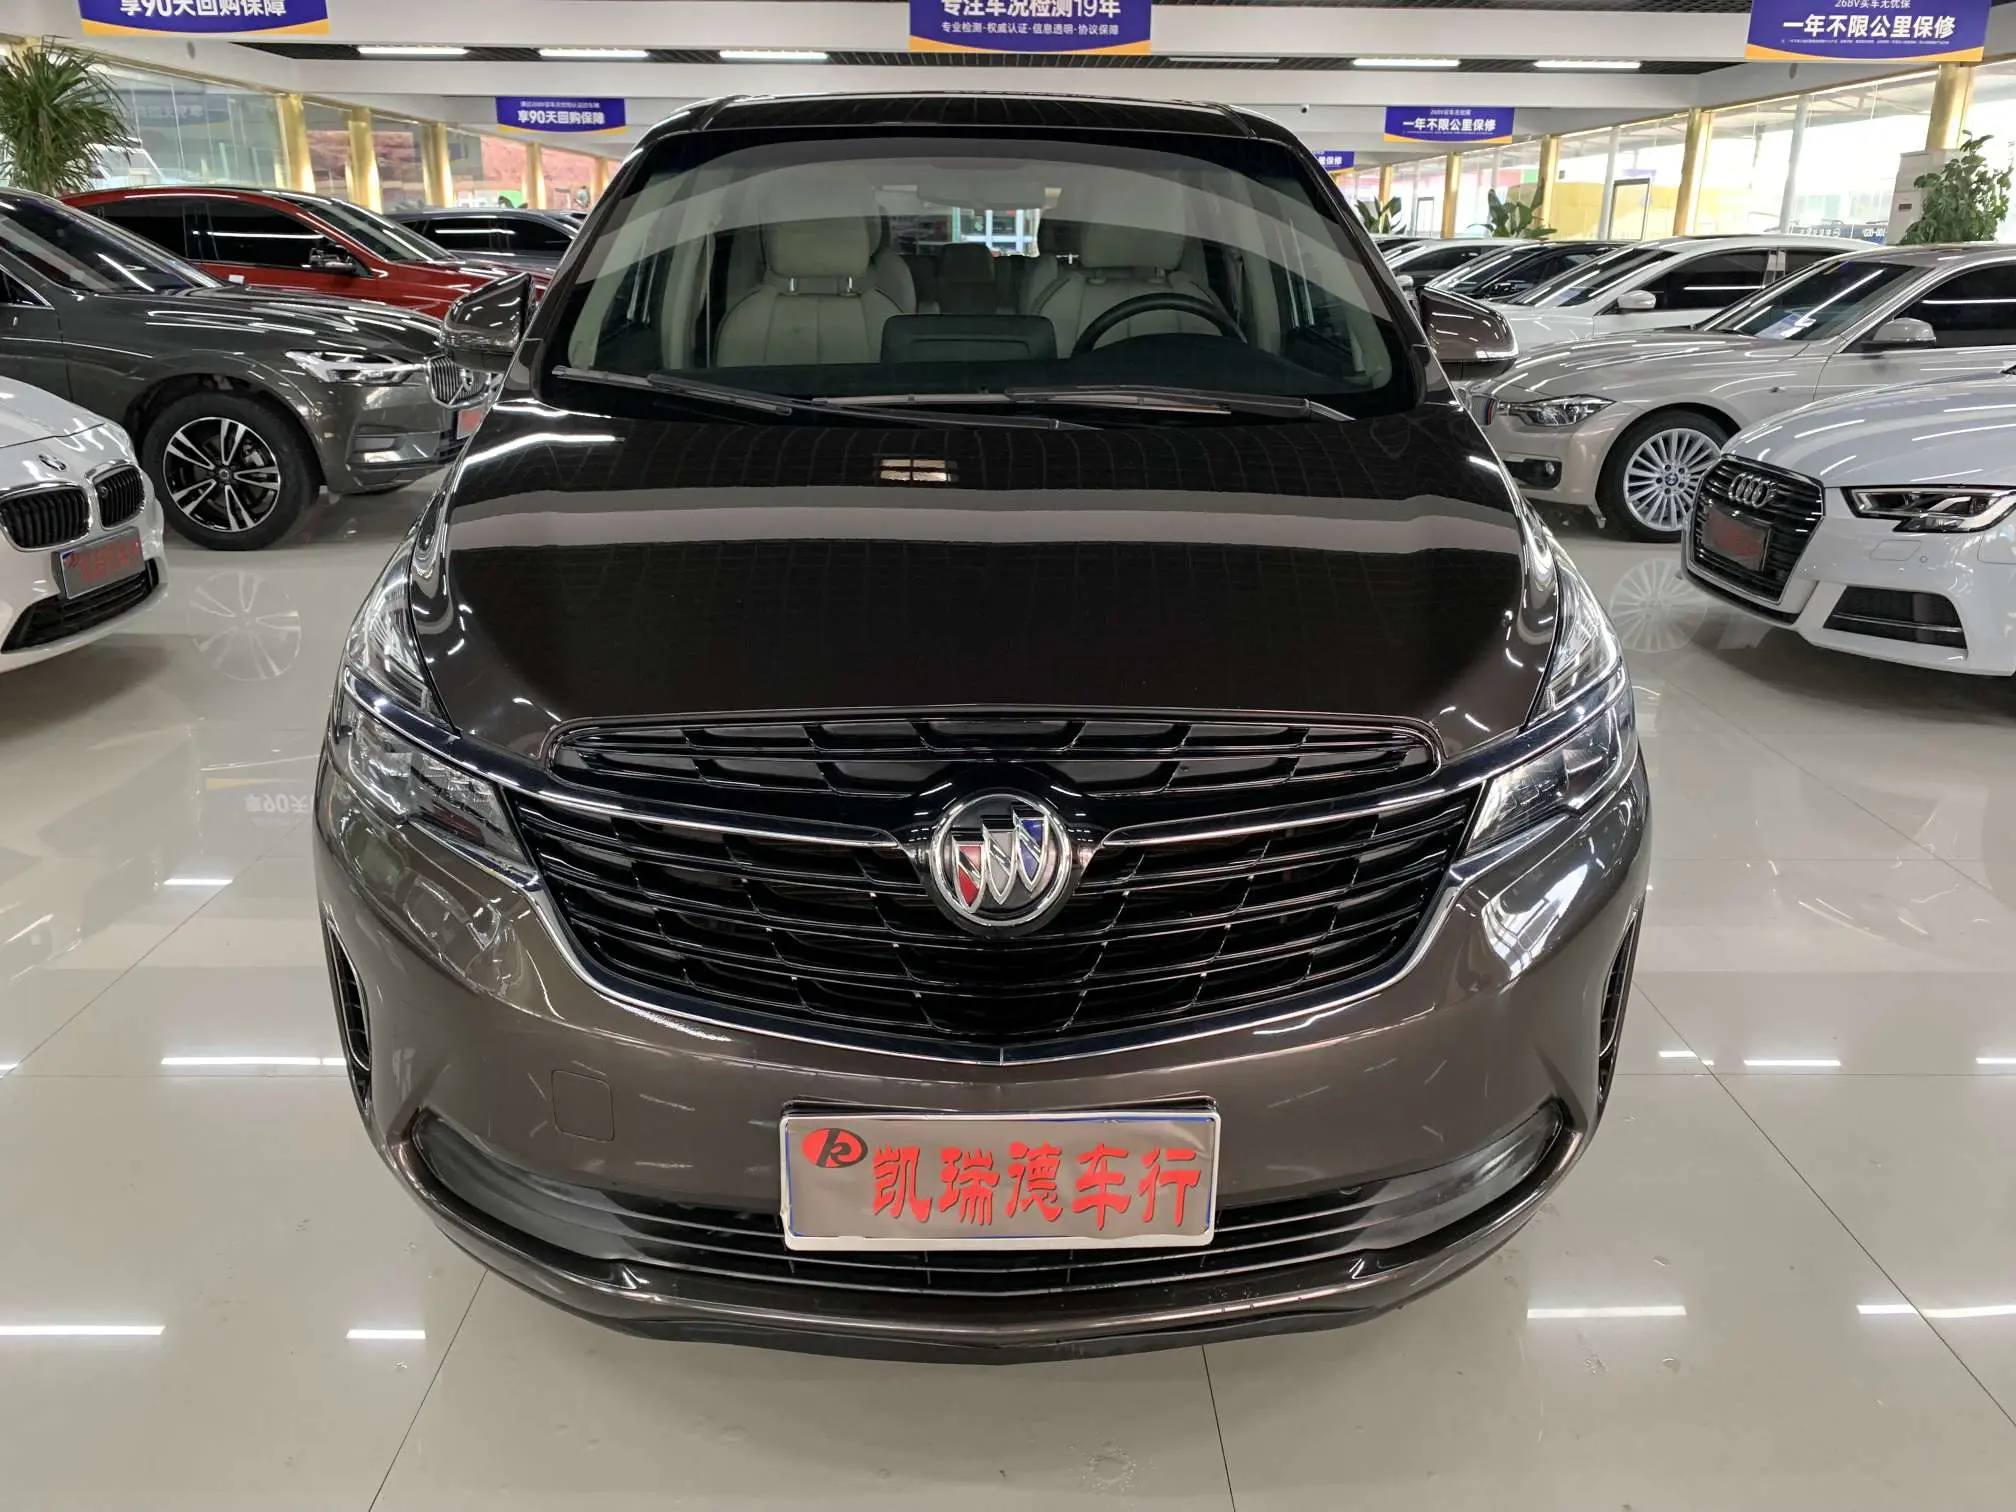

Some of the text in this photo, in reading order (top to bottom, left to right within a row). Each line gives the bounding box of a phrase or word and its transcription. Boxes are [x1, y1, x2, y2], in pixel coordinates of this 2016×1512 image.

[941, 0, 1121, 18] 专注车况检测19年
[1783, 14, 1956, 39] 一年不限公里保修
[518, 111, 605, 124] 享90天回购保障
[1402, 118, 1496, 132] 一年不限公里保修
[872, 1141, 1201, 1231] 凯瑞德车行
